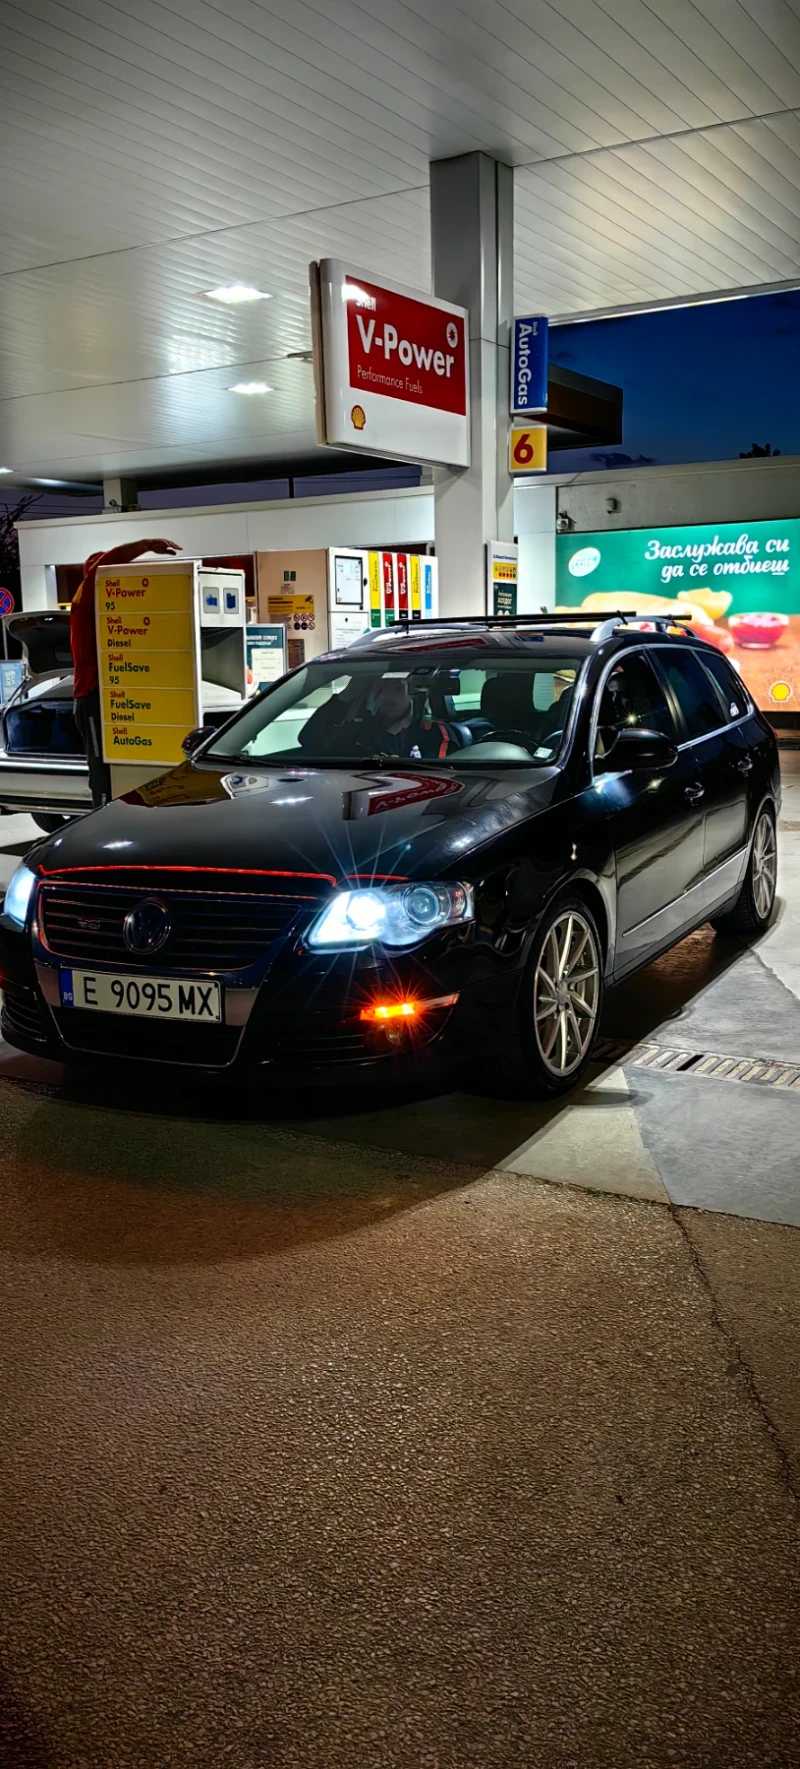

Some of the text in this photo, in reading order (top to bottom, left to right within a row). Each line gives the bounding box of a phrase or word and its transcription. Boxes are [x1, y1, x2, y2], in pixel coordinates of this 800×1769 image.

[356, 315, 455, 378] V-Power
[517, 323, 532, 406] AutoGas
[357, 364, 423, 394] Performance Fuels
[513, 433, 534, 465] 6
[644, 533, 790, 563] Заслужава си
[660, 555, 790, 584] да се отбиеш
[105, 579, 120, 587] Shell
[105, 588, 147, 598] V-Power
[105, 601, 116, 611] 95
[106, 616, 122, 624] Shell
[107, 625, 148, 636] V-Power
[107, 638, 132, 648] Diesel
[108, 654, 124, 662] Shell
[108, 662, 150, 673] FuelSave
[109, 676, 120, 685] 95
[110, 691, 126, 699] Shell
[110, 699, 152, 710] FuelSave
[111, 712, 135, 721] Diesel
[112, 727, 128, 735] Shell
[113, 736, 153, 746] AutoGas
[63, 992, 73, 1001] BG
[83, 976, 214, 1017] E 9095 MX
